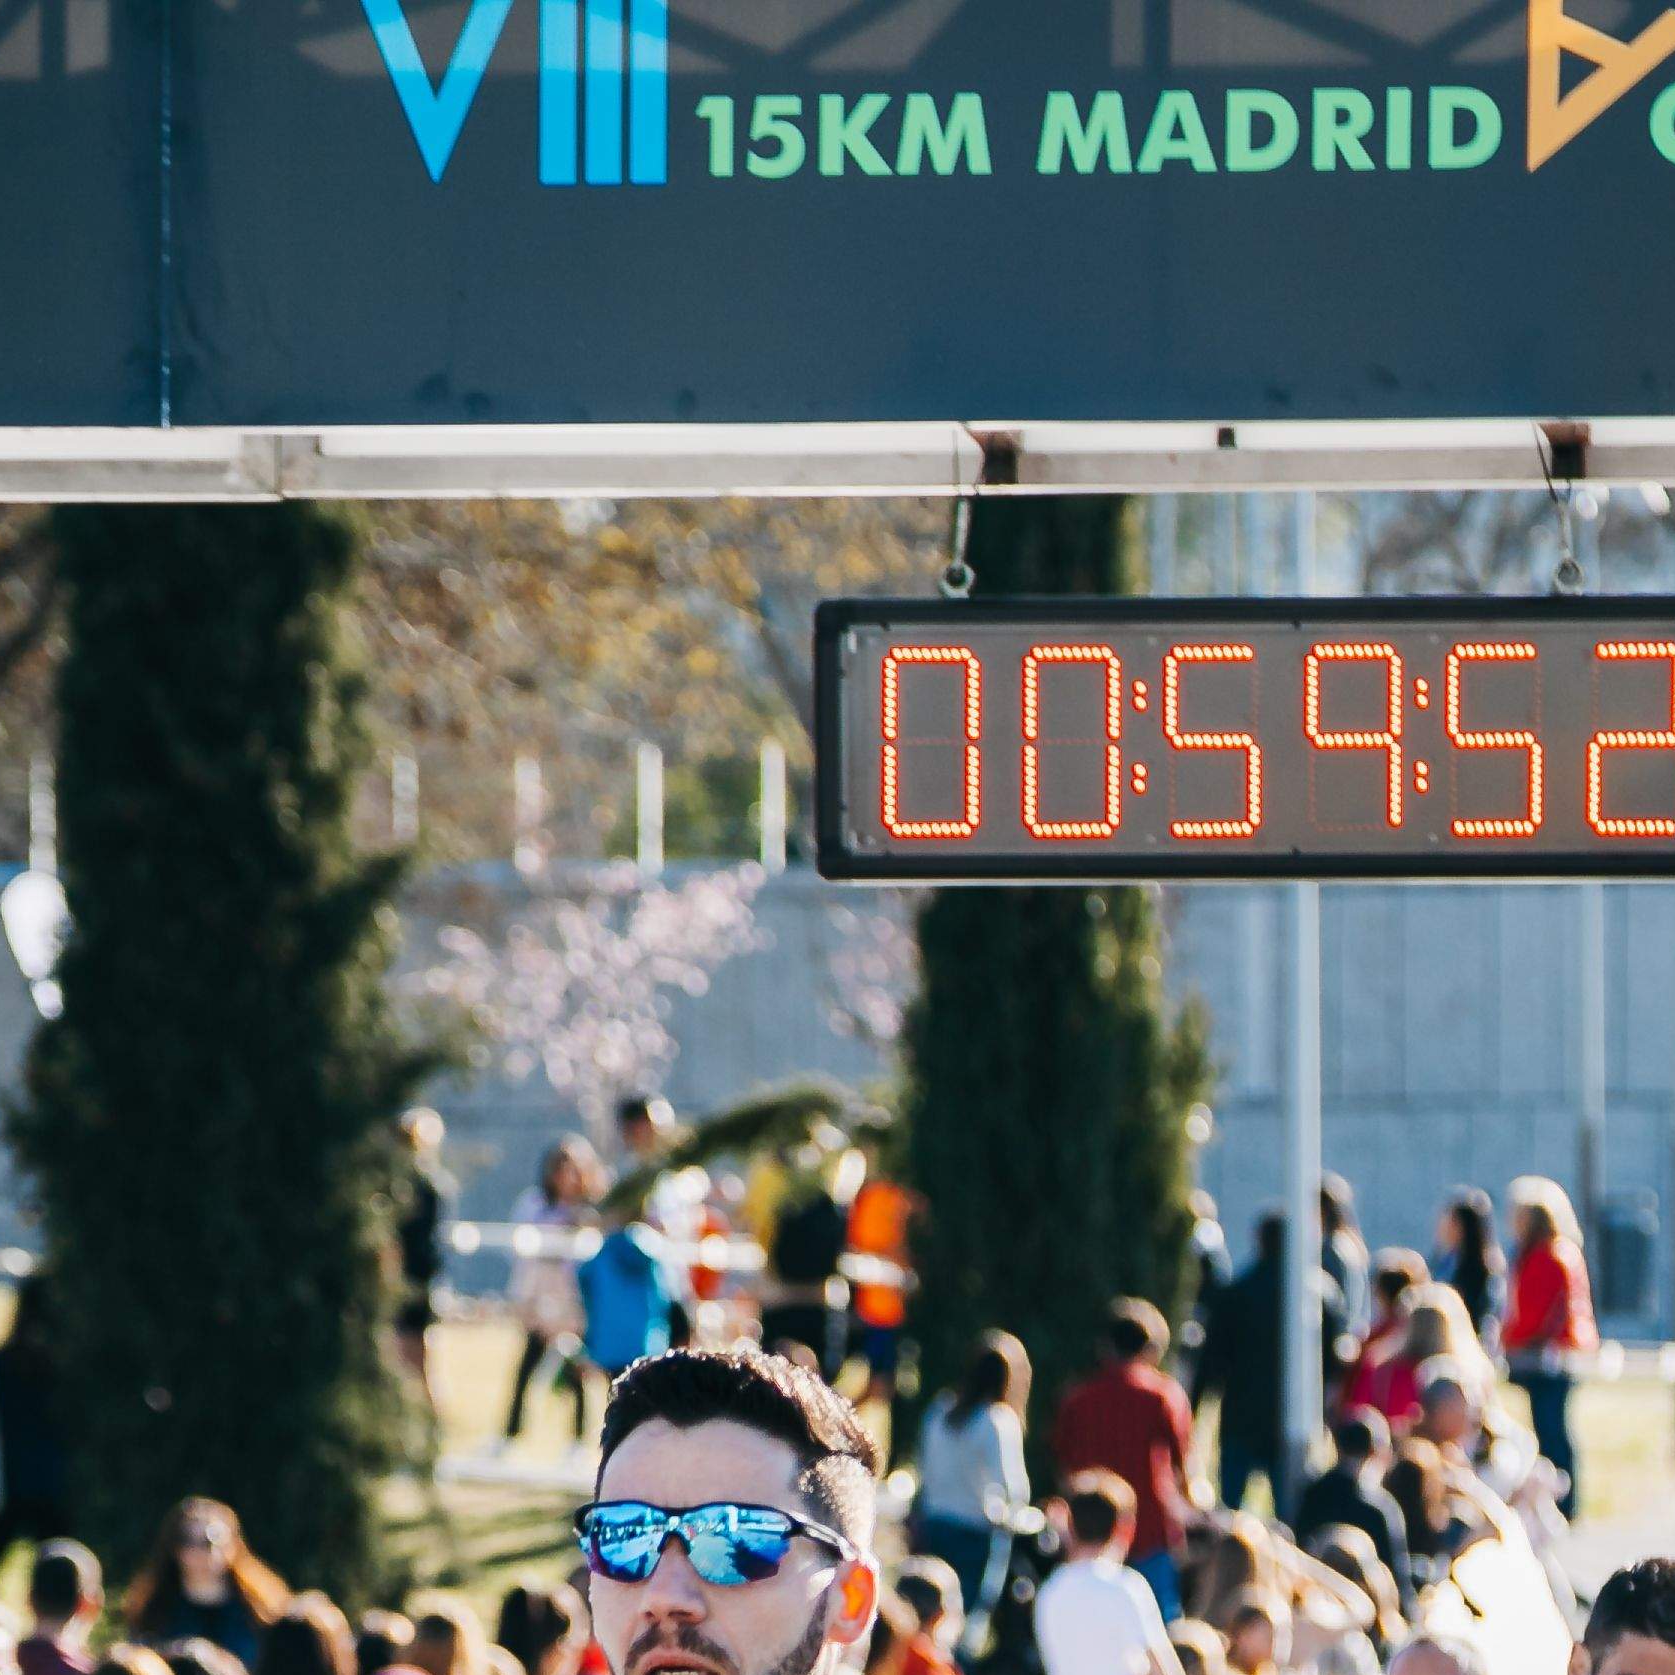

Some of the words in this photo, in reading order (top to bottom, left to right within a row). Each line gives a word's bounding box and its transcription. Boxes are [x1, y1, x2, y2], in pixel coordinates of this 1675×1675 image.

[360, 0, 668, 185] VIII
[696, 92, 992, 178] 15KM
[1035, 86, 1502, 174] MADRID
